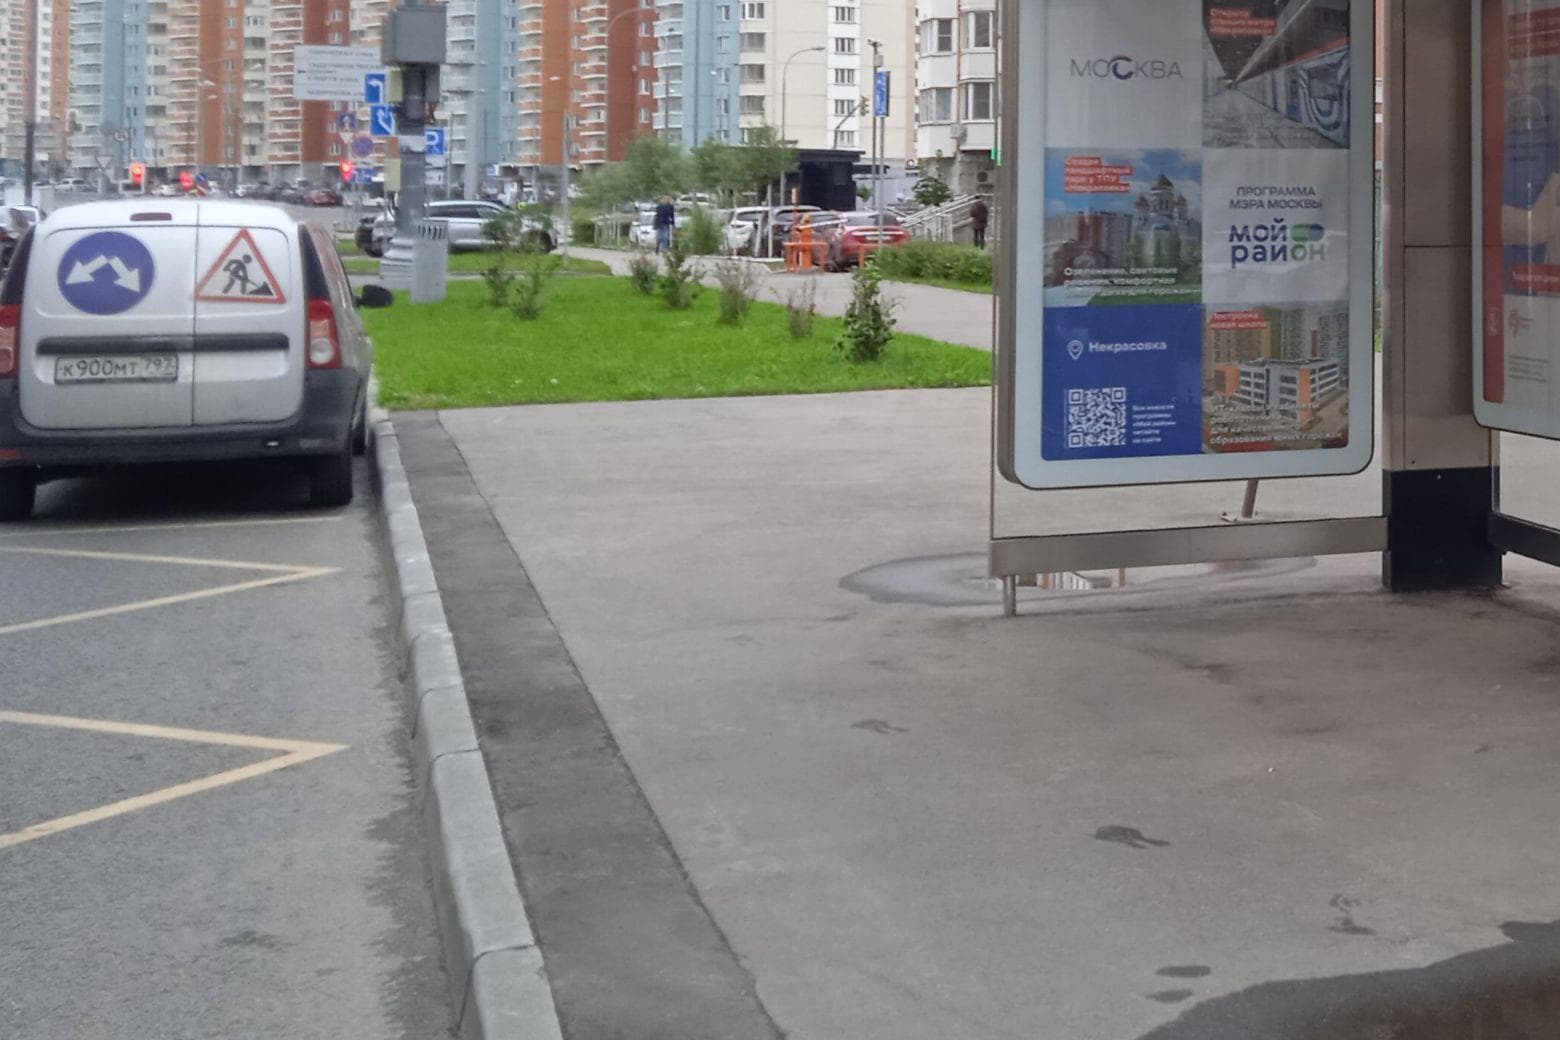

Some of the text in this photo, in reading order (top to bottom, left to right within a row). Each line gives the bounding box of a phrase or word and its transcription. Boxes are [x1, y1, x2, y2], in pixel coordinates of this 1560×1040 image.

[1070, 55, 1184, 80] МОСКВА
[1236, 186, 1316, 196] ПРОГРАММА
[1229, 199, 1322, 209] МЭРА МОСКВЫ
[1229, 218, 1287, 243] мой
[1088, 341, 1168, 354] Некрасовка
[63, 358, 138, 377] К900МТ
